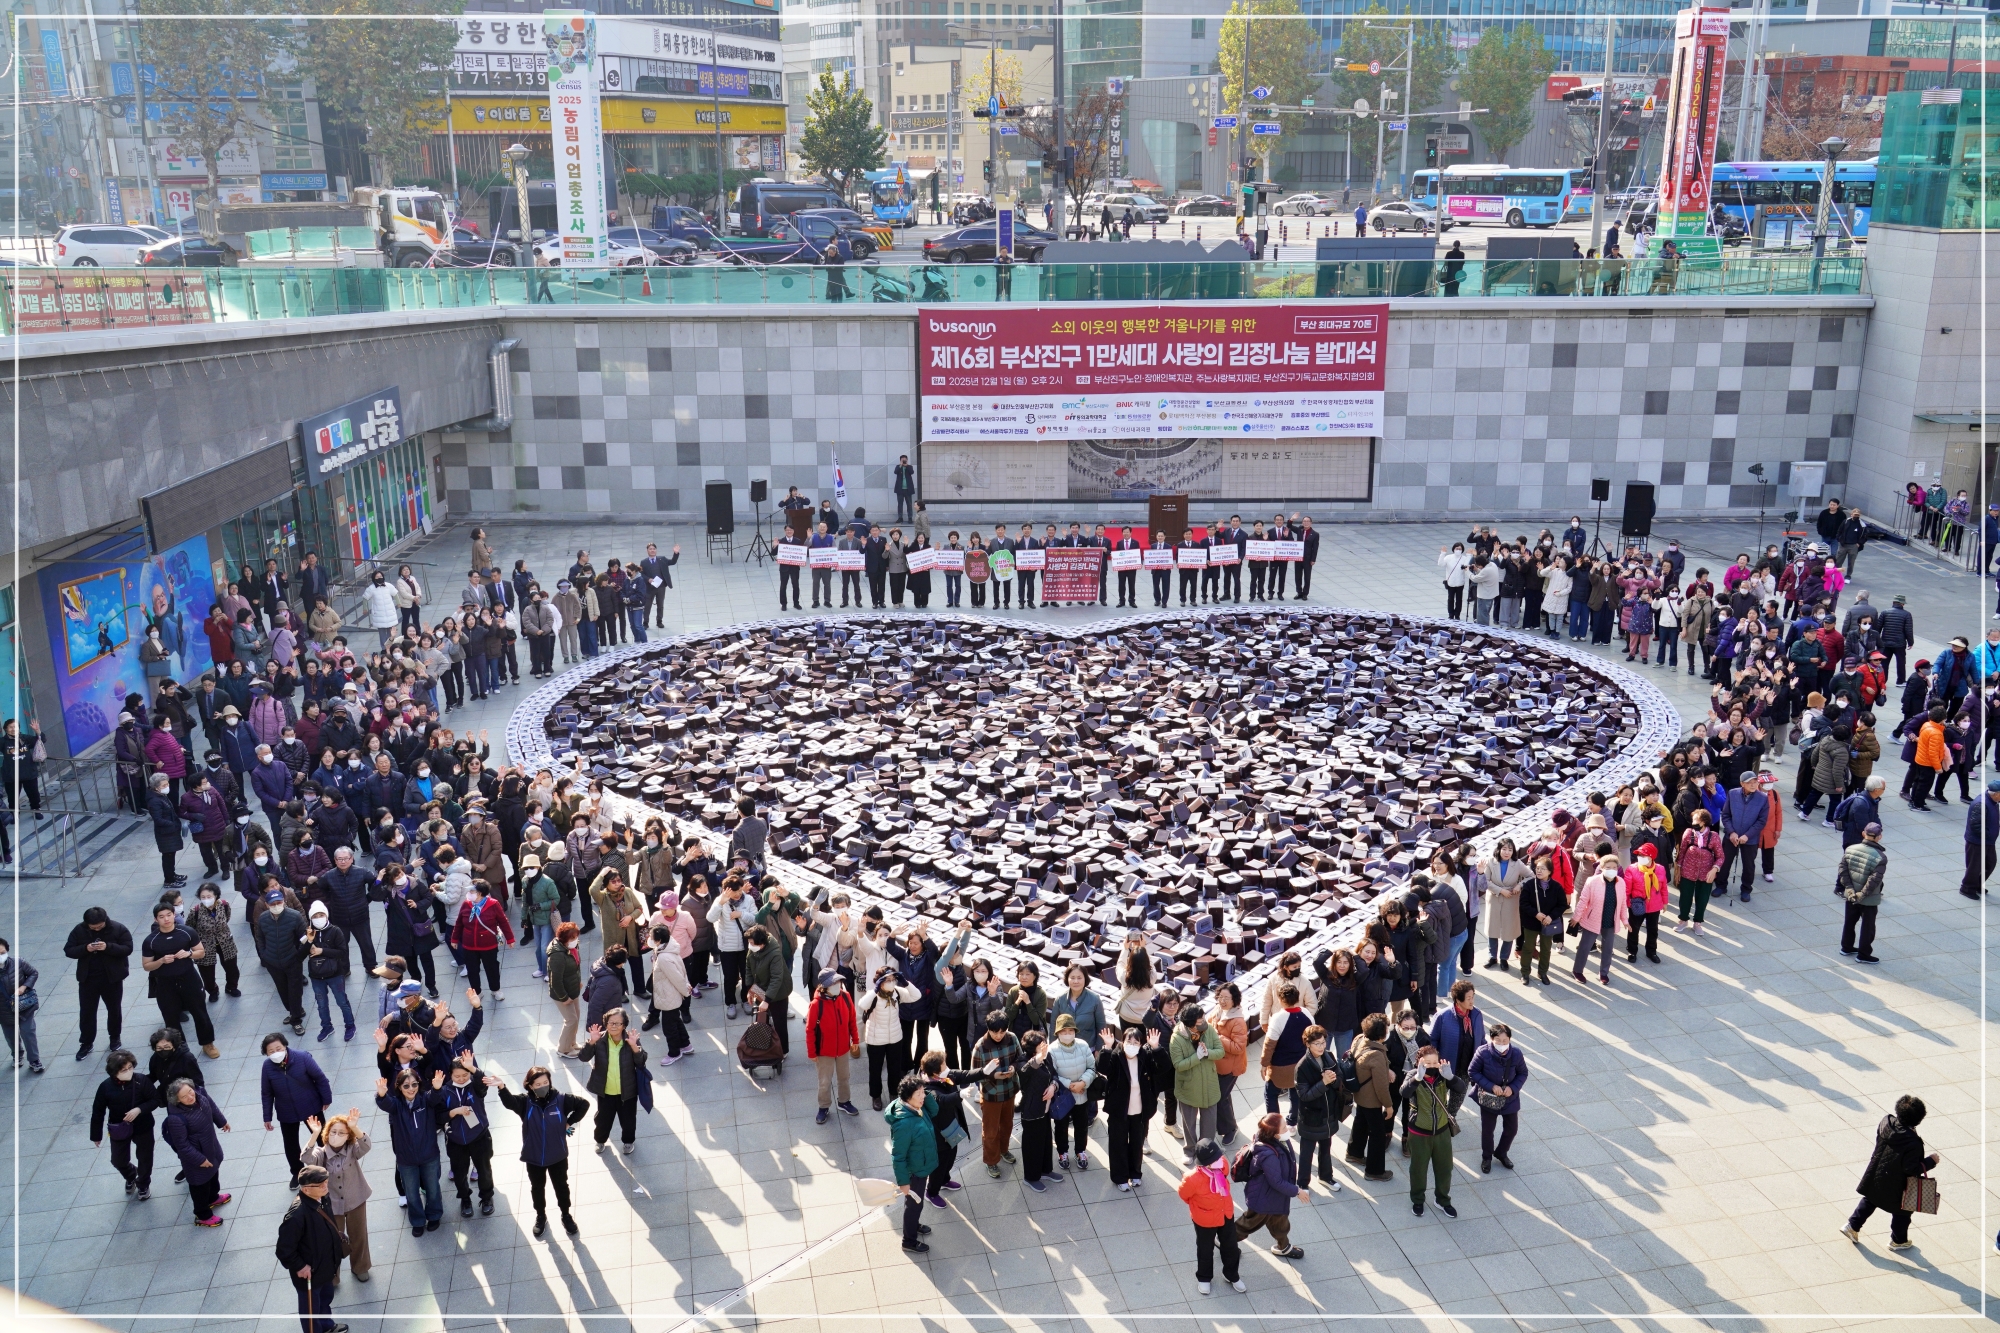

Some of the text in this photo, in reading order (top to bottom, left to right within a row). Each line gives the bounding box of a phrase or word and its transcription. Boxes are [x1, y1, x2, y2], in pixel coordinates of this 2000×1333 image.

[607, 70, 619, 86] 3F
[558, 96, 582, 104] 2025
[489, 109, 531, 120] 이바돔
[564, 107, 585, 233] 농림어업총조사
[169, 191, 191, 211] 약
[1765, 205, 1813, 215] 송상현광장
[930, 319, 996, 336] busanjin
[1050, 318, 1256, 335] 소외 이웃의 행복한 겨울나기를 위한
[1300, 319, 1372, 330] 부산 최대규모 70톤
[931, 340, 1376, 369] 제16회 부산진구 1만세대 사랑의 김장나눔 발대식
[949, 377, 979, 386] 2025년
[981, 377, 998, 386] 12월
[1000, 377, 1012, 386] 1일
[1013, 376, 1028, 386] (월)
[1031, 376, 1047, 385] 오후
[1049, 375, 1063, 385] 2시
[1196, 373, 1262, 384] 주는사랑복지재단,
[1263, 372, 1375, 383] 부산진구기독교문화복지협의회
[1047, 562, 1098, 571] 사랑의 김장나눔
